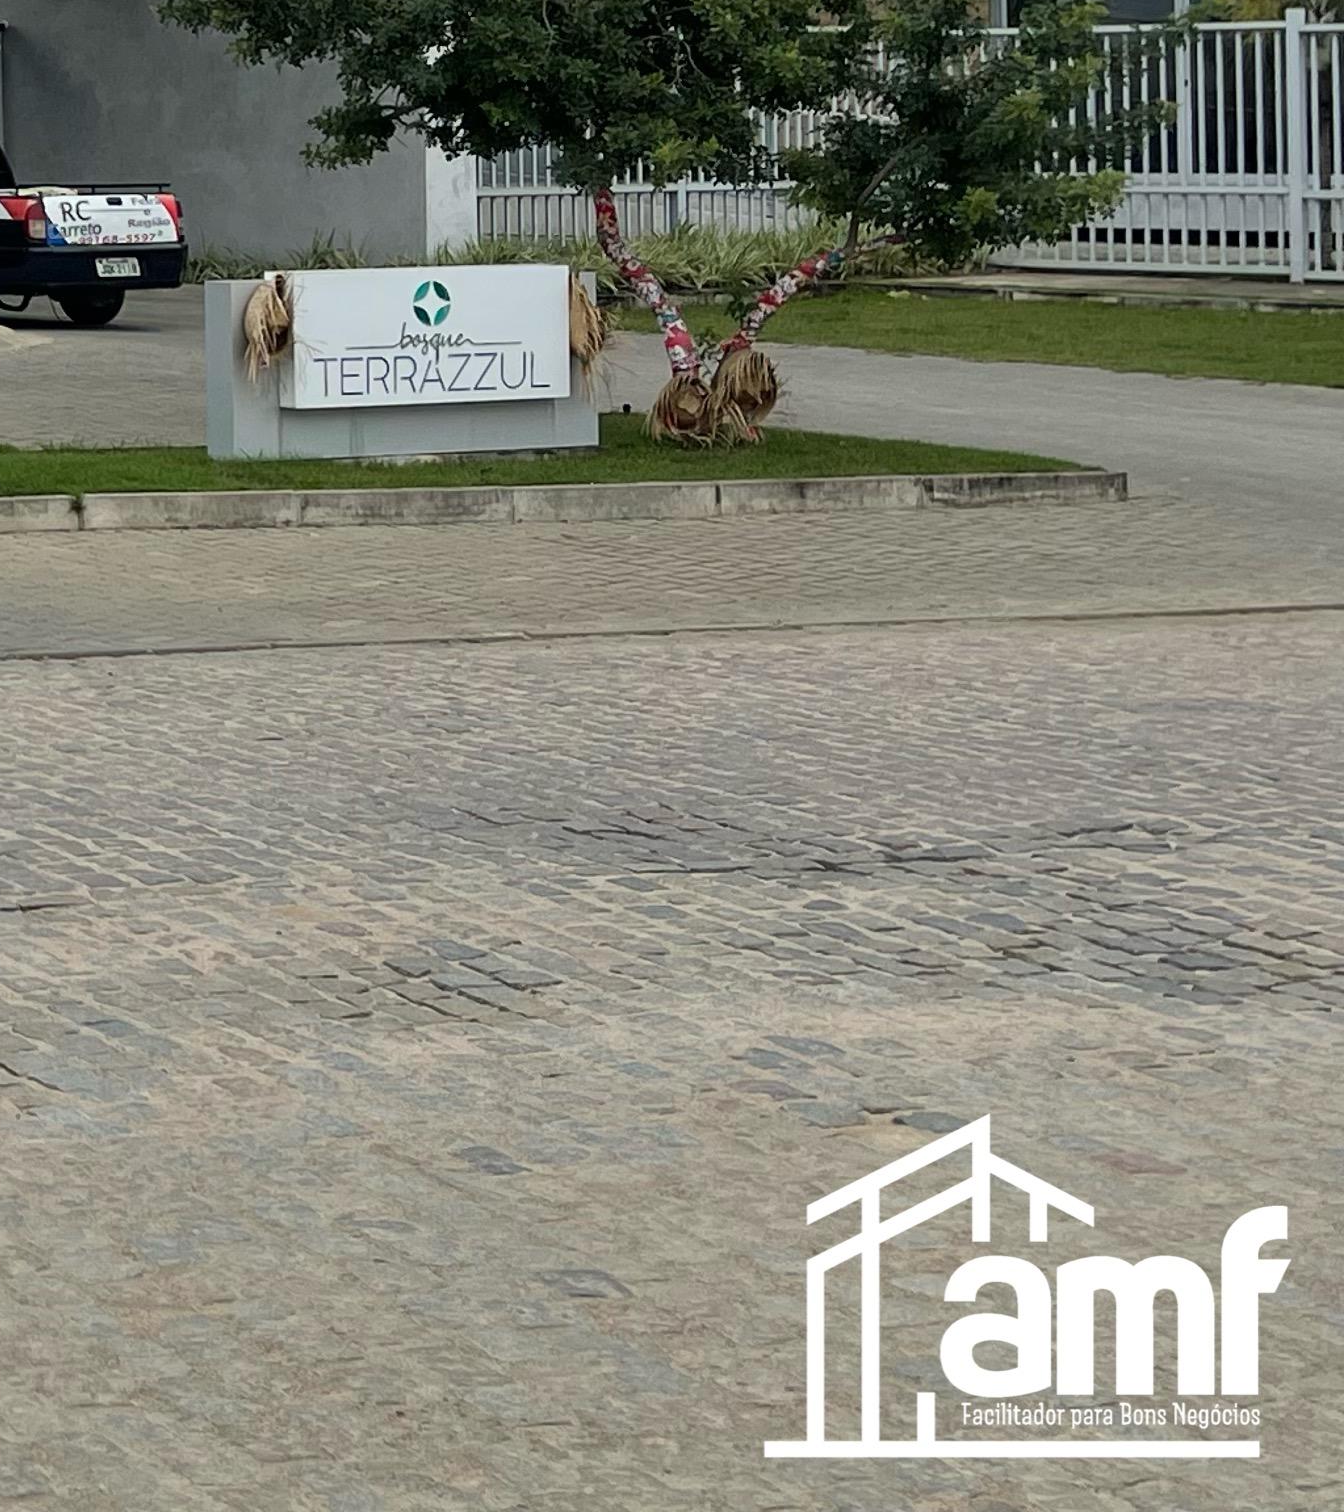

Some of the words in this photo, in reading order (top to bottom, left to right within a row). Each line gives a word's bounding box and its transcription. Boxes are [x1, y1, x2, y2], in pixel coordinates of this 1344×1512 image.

[60, 200, 92, 222] RC
[396, 322, 475, 364] bosque
[313, 350, 551, 398] TERRAZZUL
